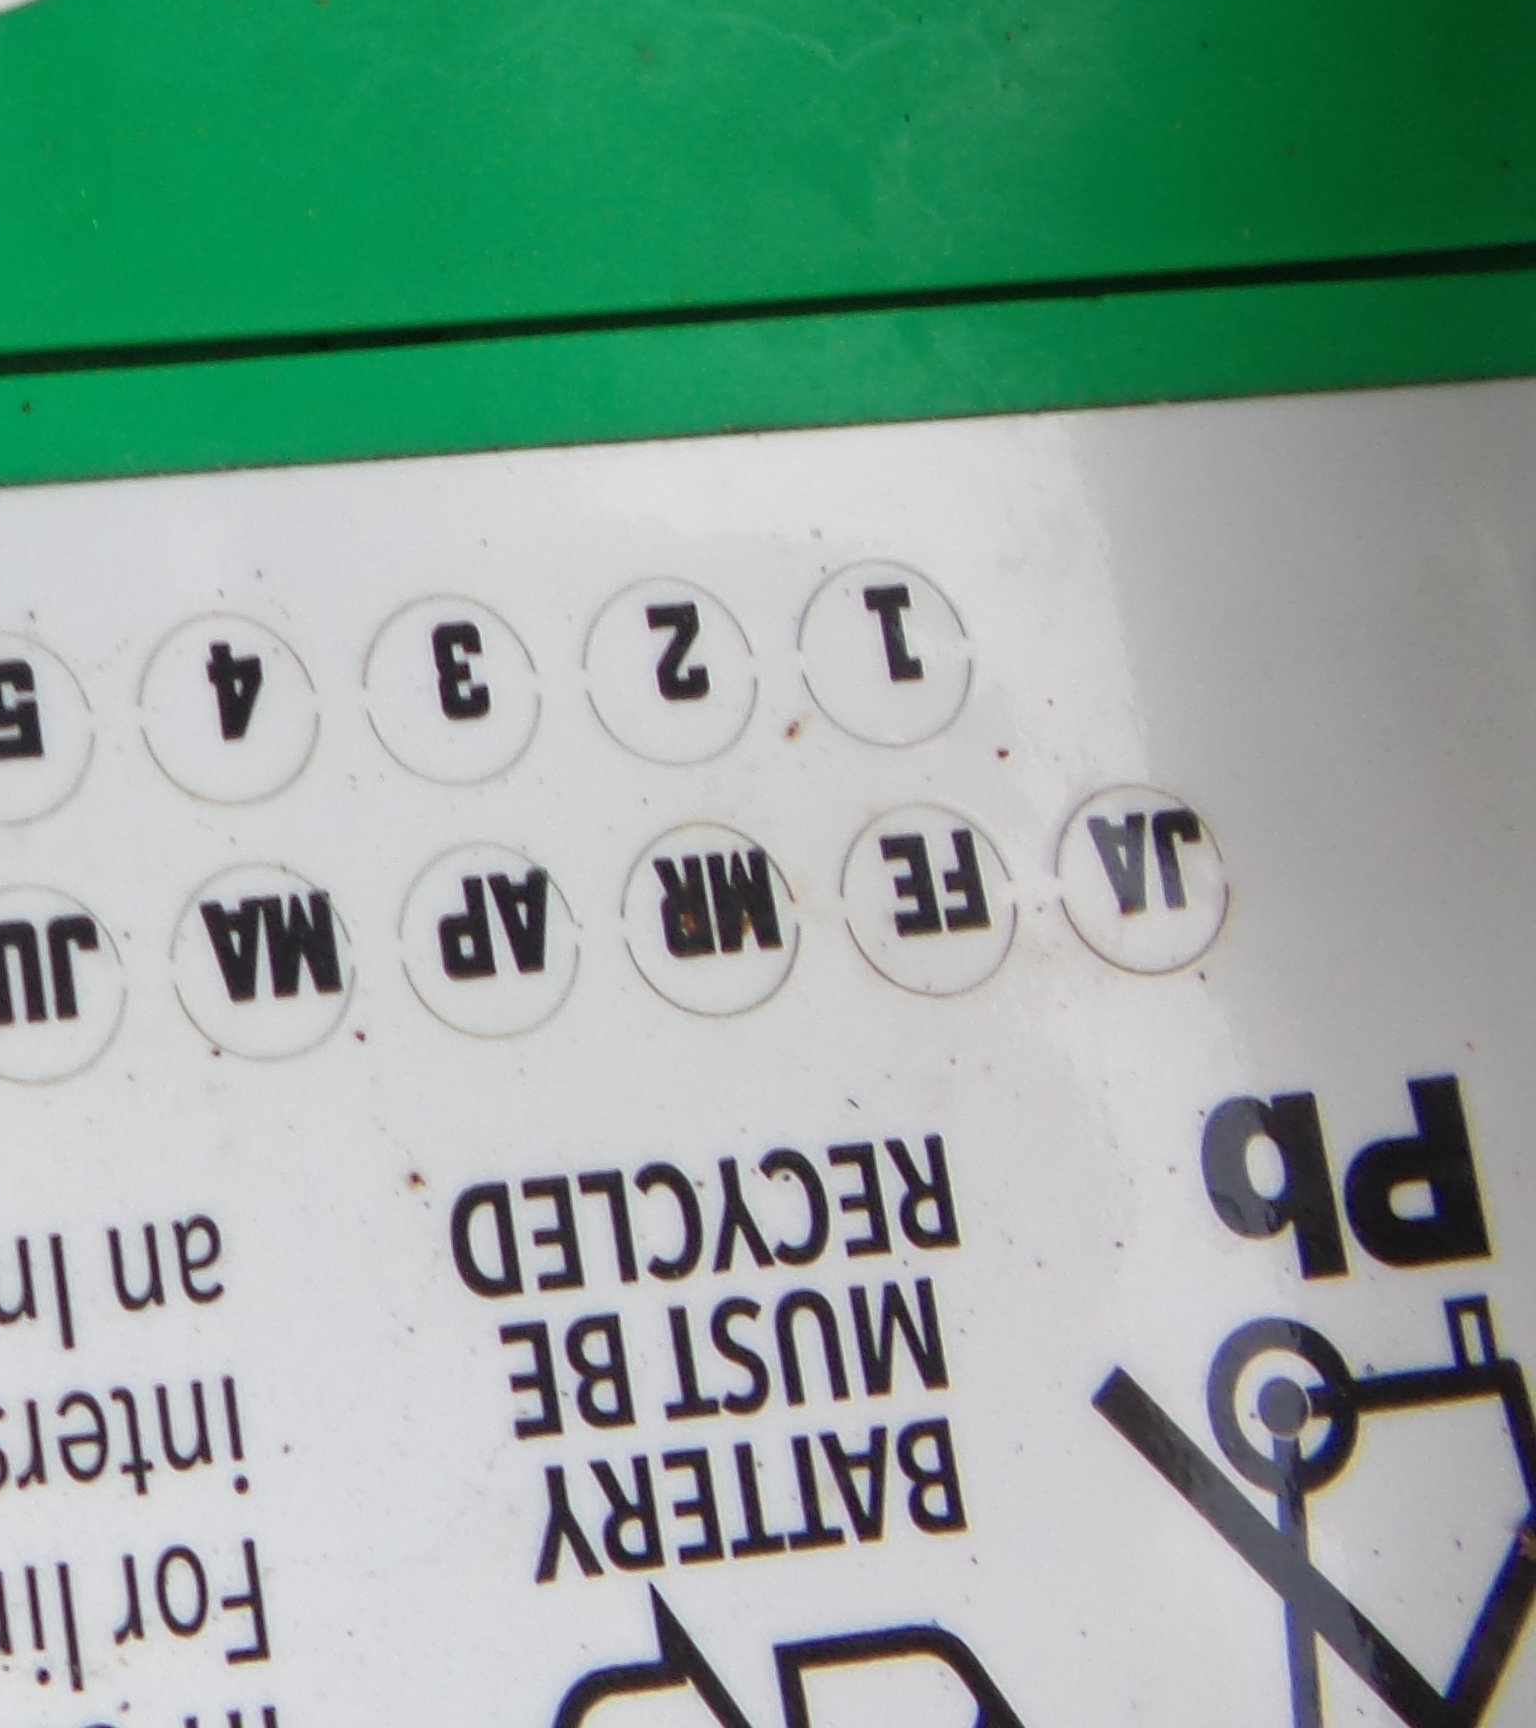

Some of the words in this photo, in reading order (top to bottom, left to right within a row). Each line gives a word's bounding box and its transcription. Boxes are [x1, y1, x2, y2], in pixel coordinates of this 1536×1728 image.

[431, 621, 491, 721] 3
[645, 601, 710, 702] 2
[863, 583, 923, 682] 1
[206, 642, 263, 741] 4
[652, 842, 780, 959] MR
[879, 828, 991, 938] FE
[1088, 807, 1201, 915] JA
[199, 890, 343, 1002] MA
[438, 866, 550, 981] AP
[450, 1134, 960, 1299] RECYCLED
[1201, 1075, 1492, 1279] Pb
[107, 1214, 224, 1312] an
[499, 1313, 636, 1440] BE
[665, 1277, 949, 1421] MUST
[535, 1417, 967, 1584] BATTERY
[114, 1538, 271, 1665] For
